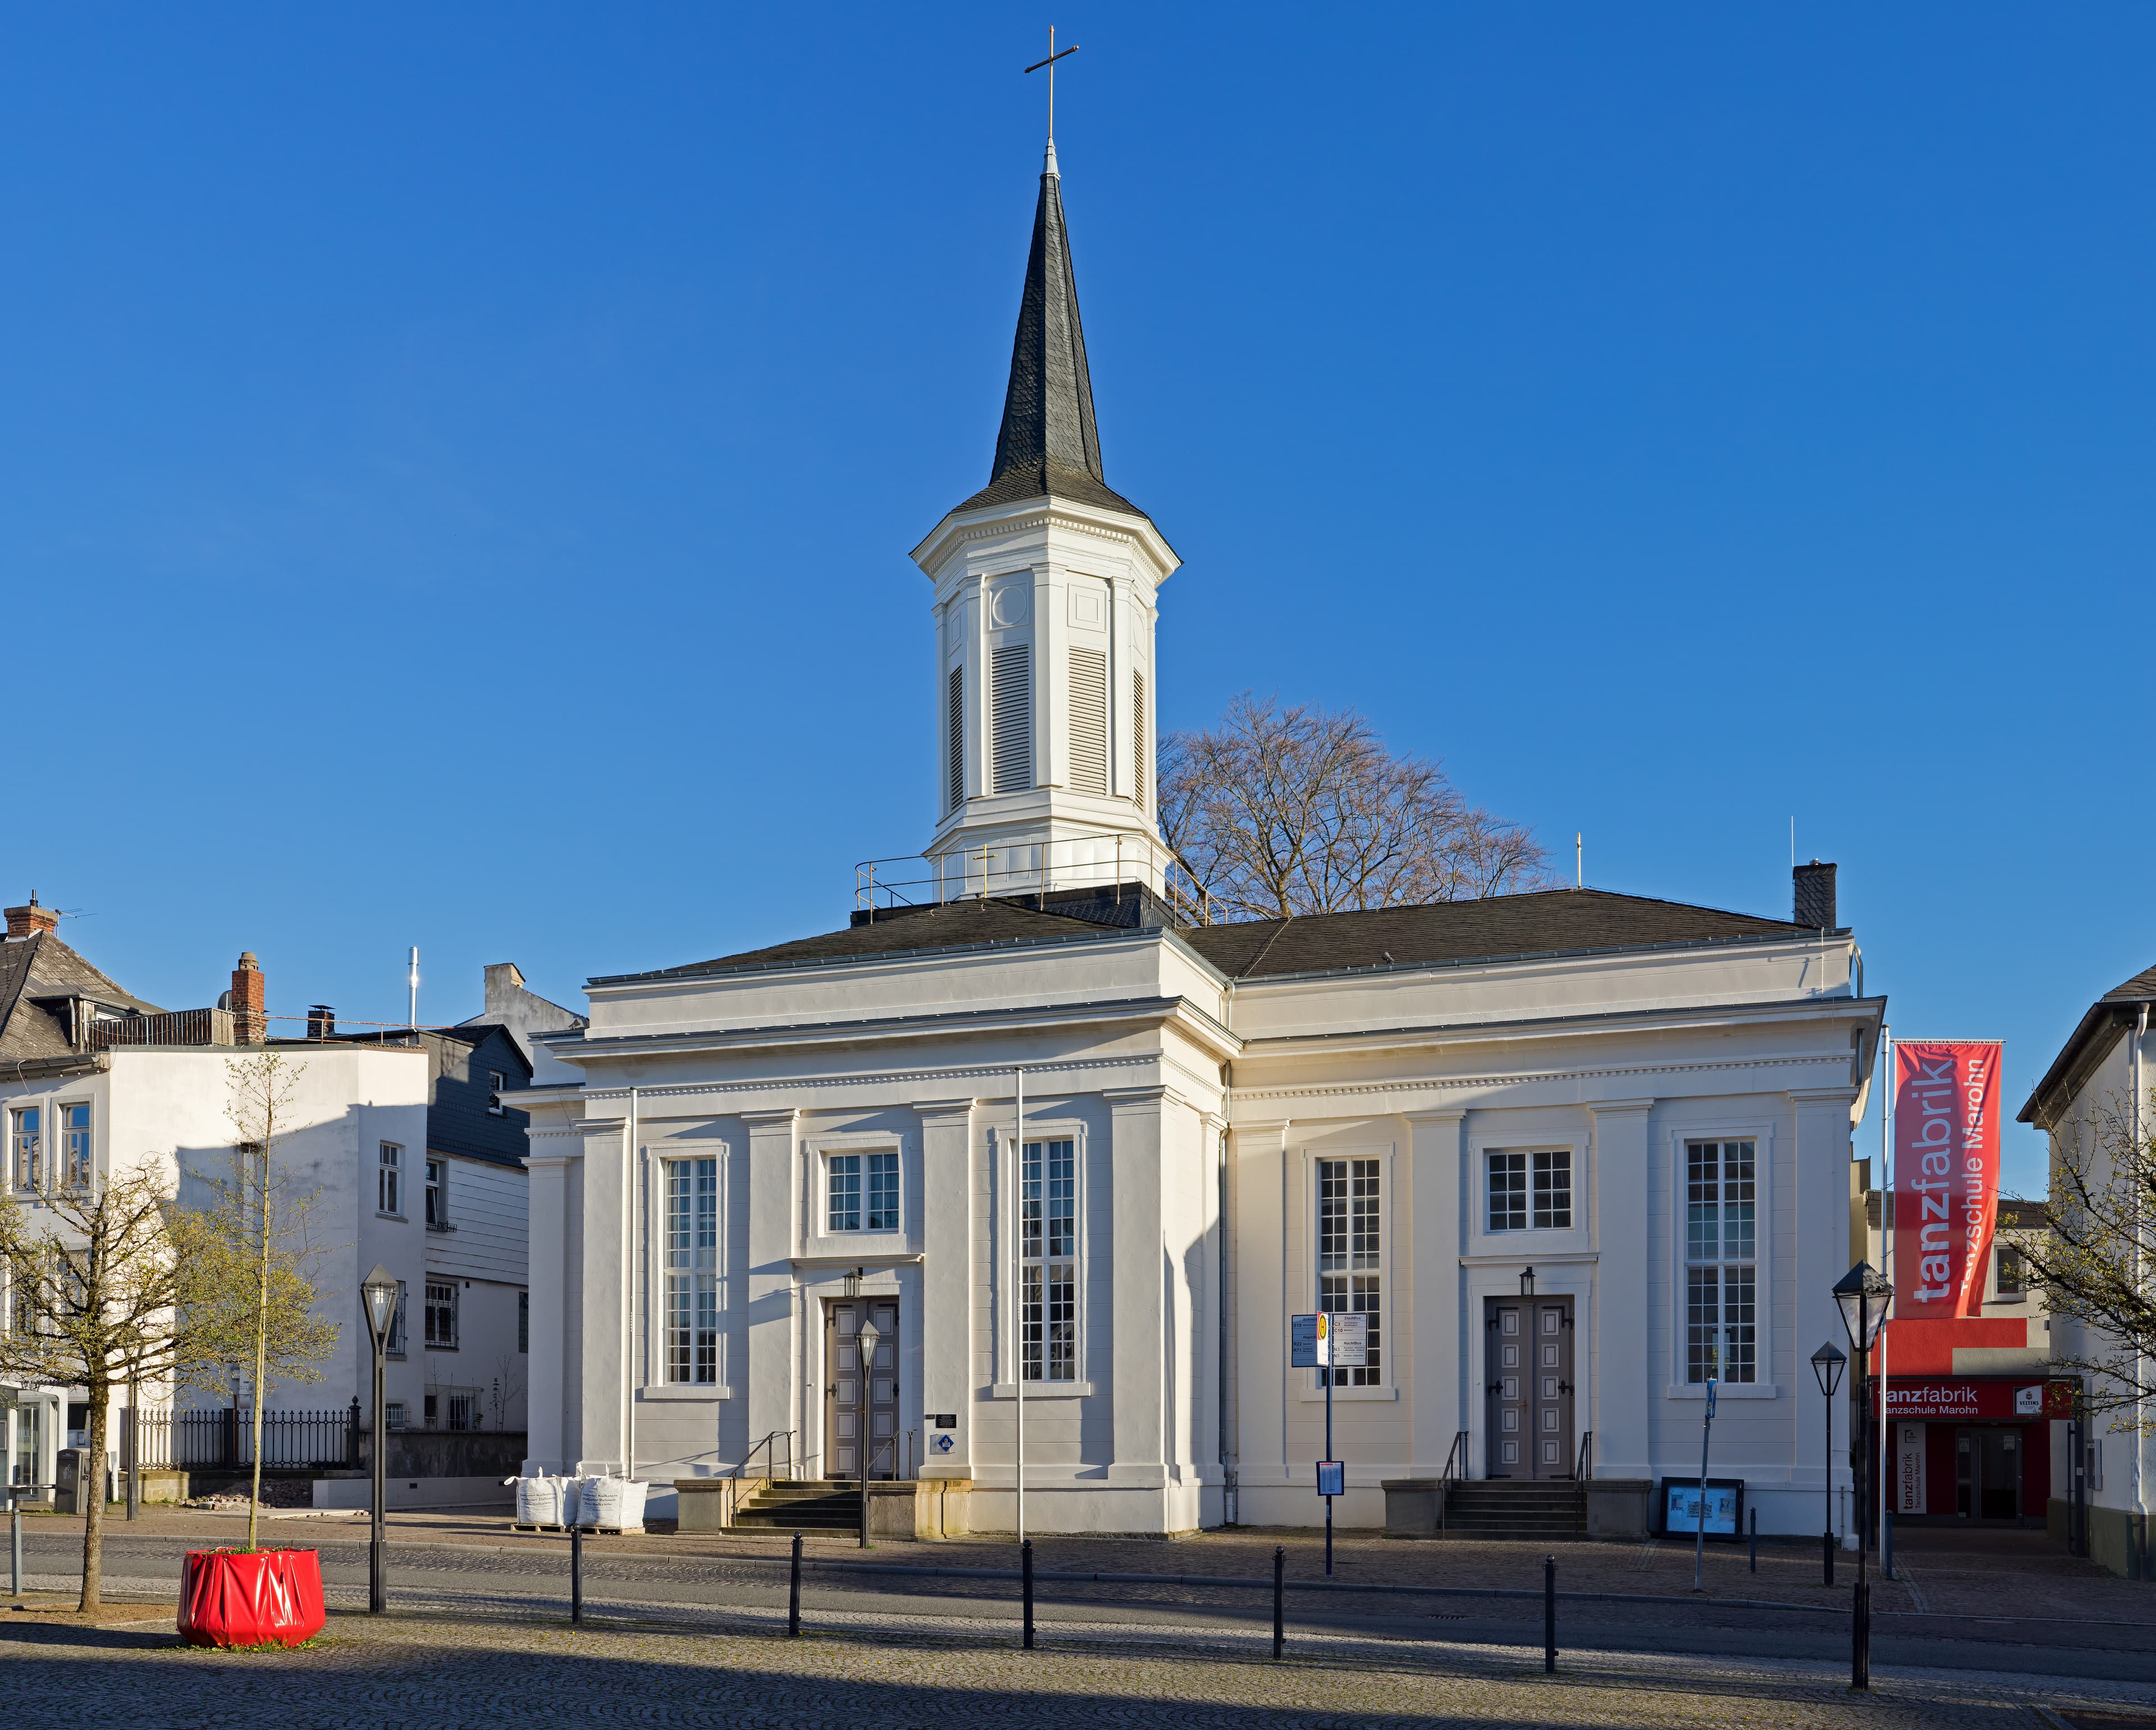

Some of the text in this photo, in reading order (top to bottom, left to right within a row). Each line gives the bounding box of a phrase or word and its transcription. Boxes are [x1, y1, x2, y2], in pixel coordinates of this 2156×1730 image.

[1911, 1060, 1952, 1303] tanzfabrik
[1961, 1060, 1984, 1297] Tanzschule Marohn
[1902, 1453, 1913, 1510] tanzfabrik
